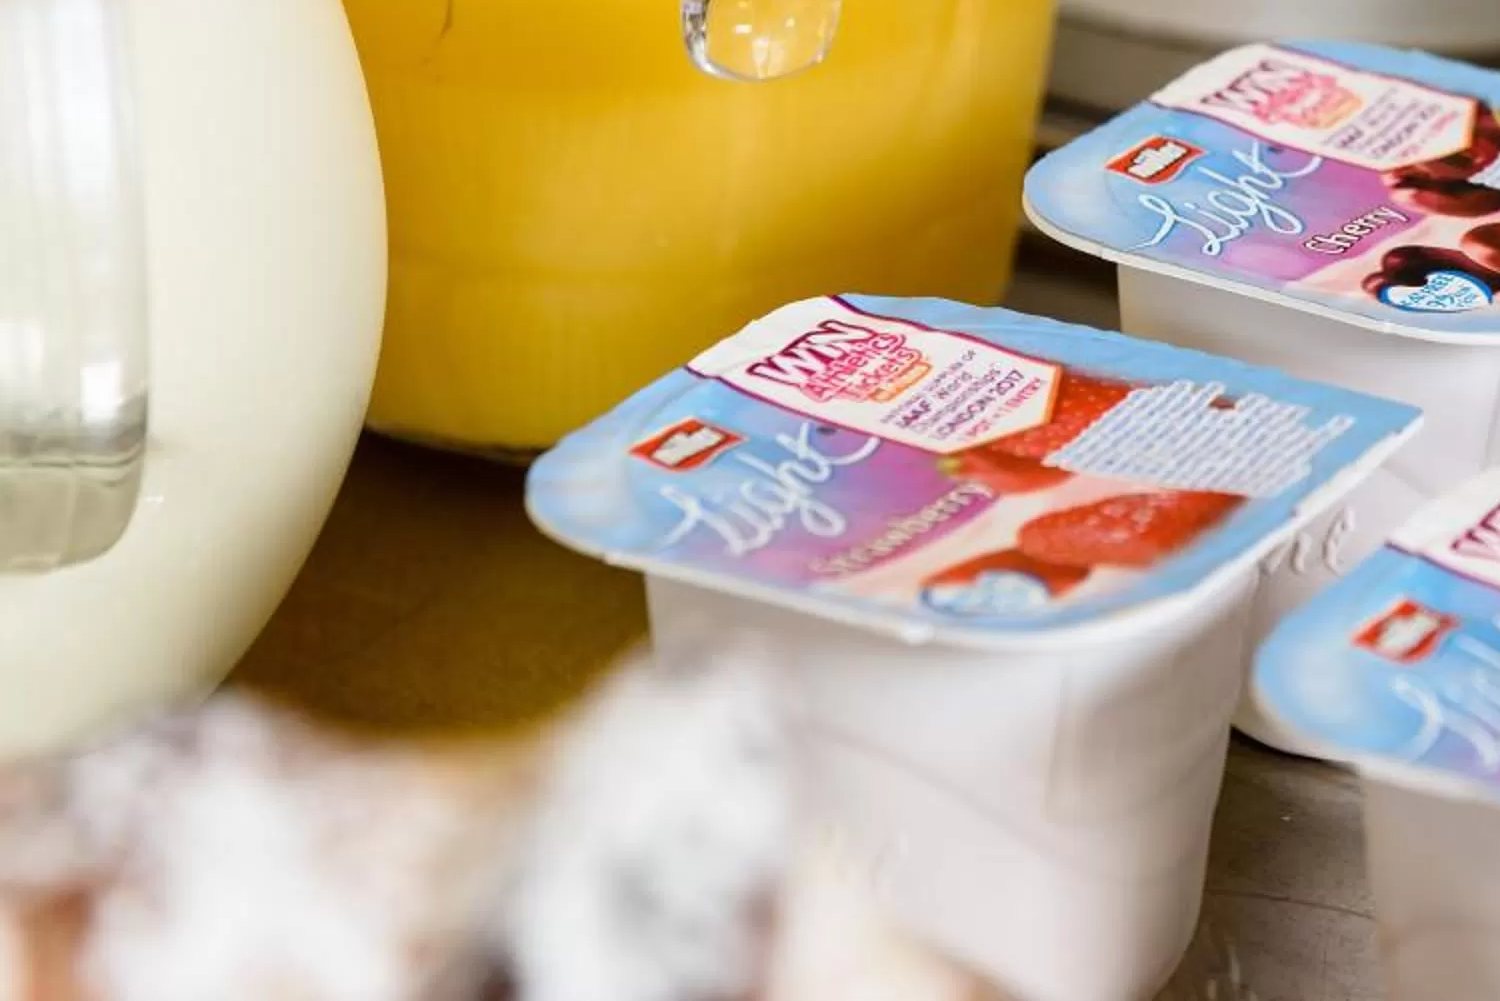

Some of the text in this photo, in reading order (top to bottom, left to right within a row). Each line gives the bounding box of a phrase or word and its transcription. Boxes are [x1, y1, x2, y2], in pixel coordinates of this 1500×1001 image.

[1136, 140, 1324, 255] Light
[1303, 205, 1411, 255] Cherry
[745, 319, 879, 389] WIN
[804, 333, 904, 402] Athletics
[839, 347, 918, 401] Tickets
